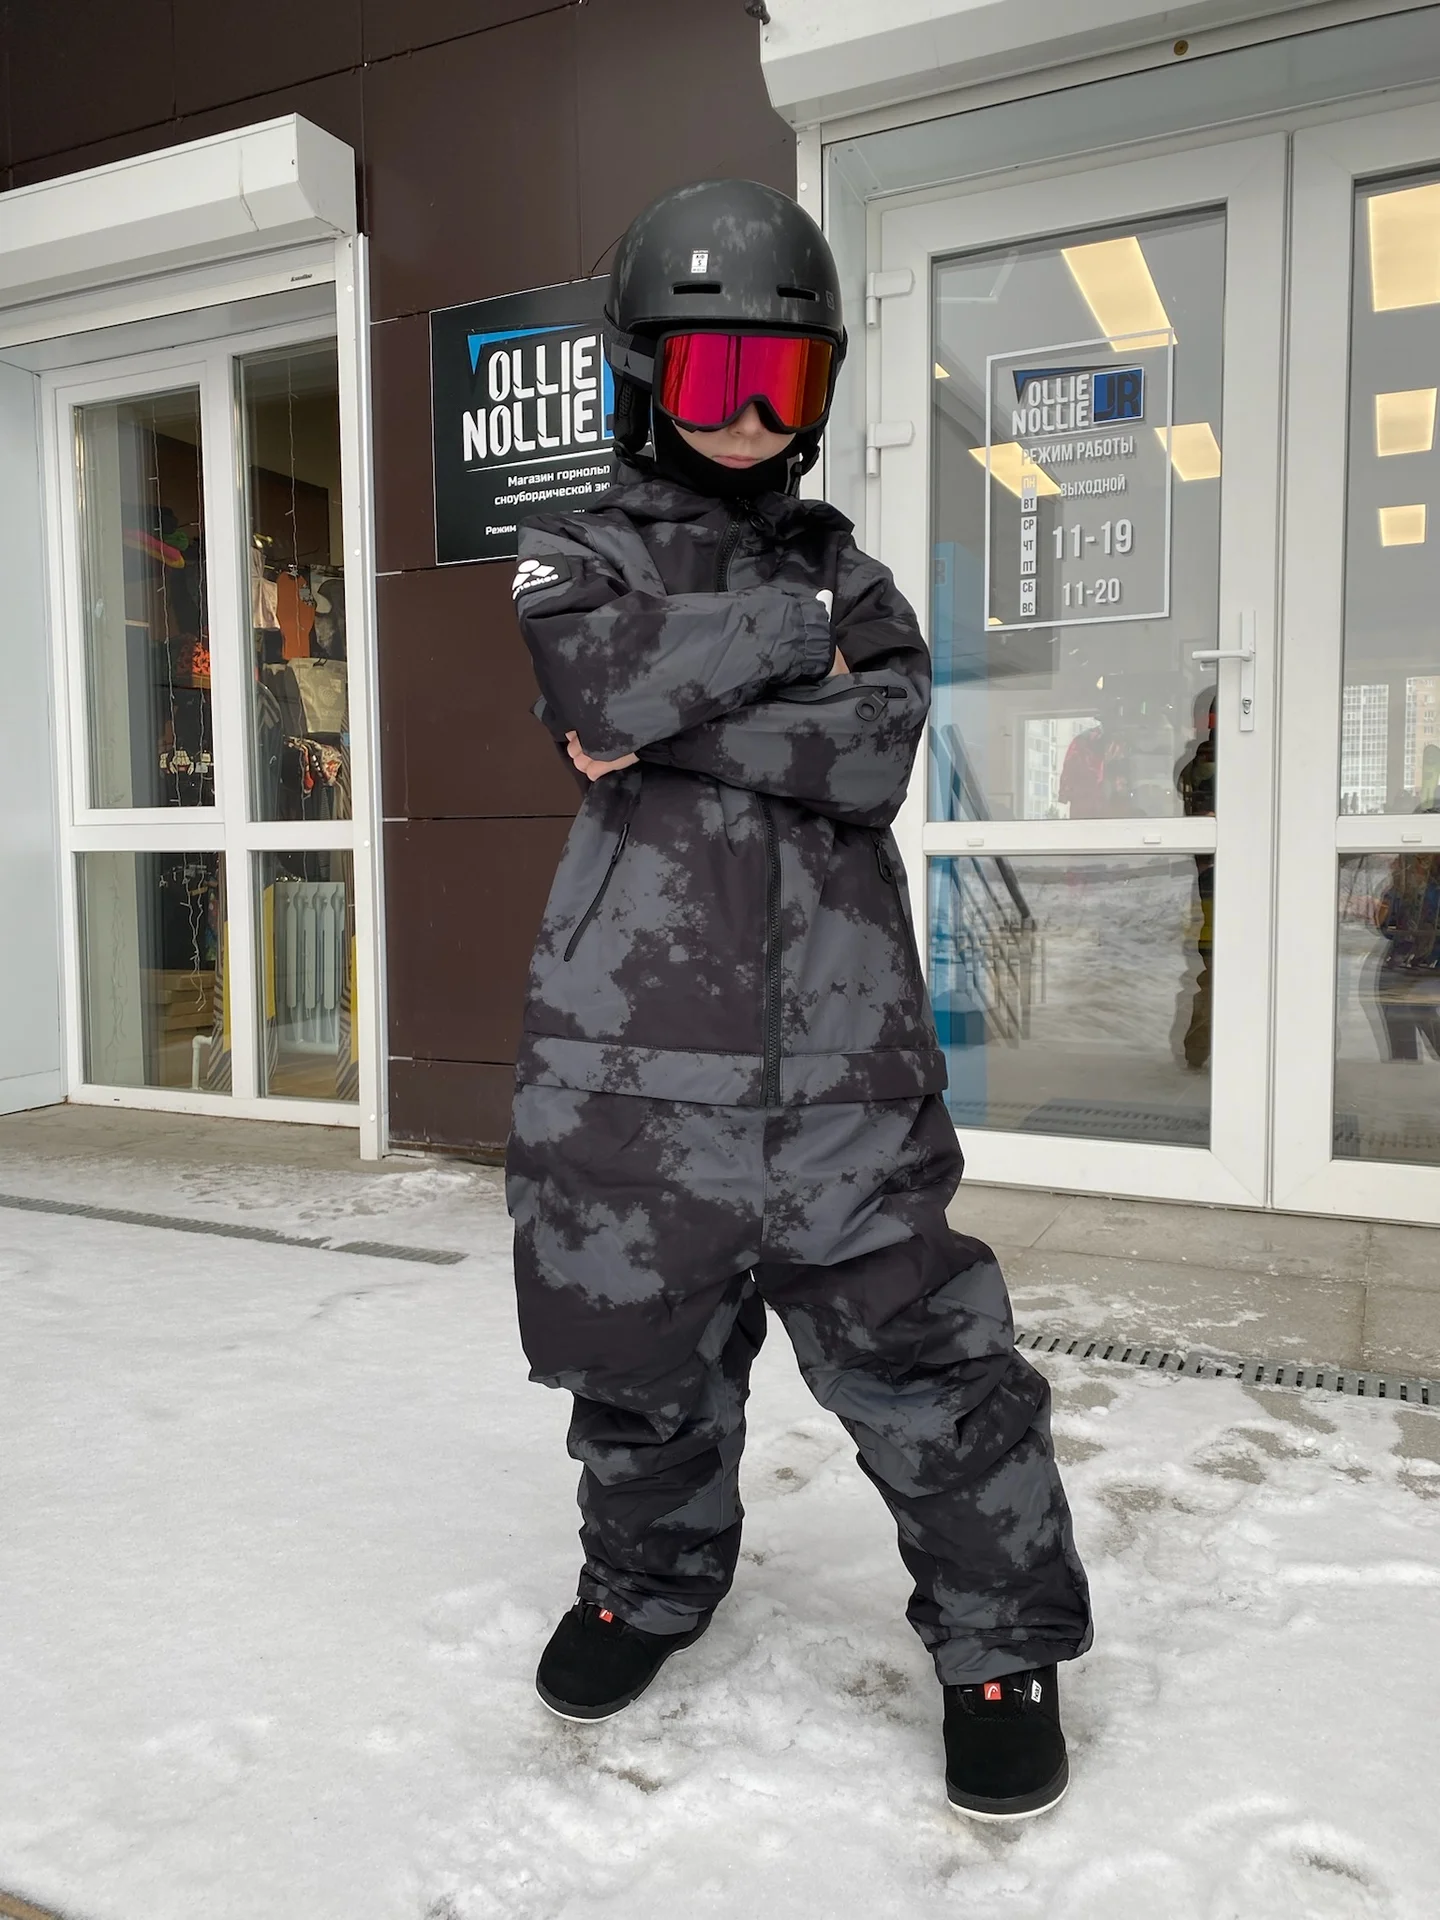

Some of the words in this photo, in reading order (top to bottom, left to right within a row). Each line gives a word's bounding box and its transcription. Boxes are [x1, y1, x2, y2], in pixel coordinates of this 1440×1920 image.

[488, 335, 597, 402] OLLIE
[1028, 374, 1090, 407] OLLIE
[1094, 373, 1141, 421] JR
[462, 389, 598, 462] NOLLIE
[1012, 400, 1090, 436] NOLLIE
[1021, 443, 1073, 464] РЕЖИМ
[1076, 436, 1134, 459] РАБОТЫ
[507, 472, 555, 488] Магазин
[1023, 476, 1036, 489] ПН
[1060, 474, 1126, 497] ВЫХОДНОЙ
[494, 481, 593, 506] сноубордической
[1023, 498, 1035, 510] ВТ
[485, 524, 517, 536] Режим
[1023, 519, 1034, 531] СР
[1022, 540, 1034, 551] ЧТ
[1052, 518, 1132, 559] 11-19
[1022, 561, 1034, 572] ПТ
[1022, 581, 1034, 593] СБ
[1063, 577, 1121, 606] 11-20
[1022, 602, 1034, 614] ВС
